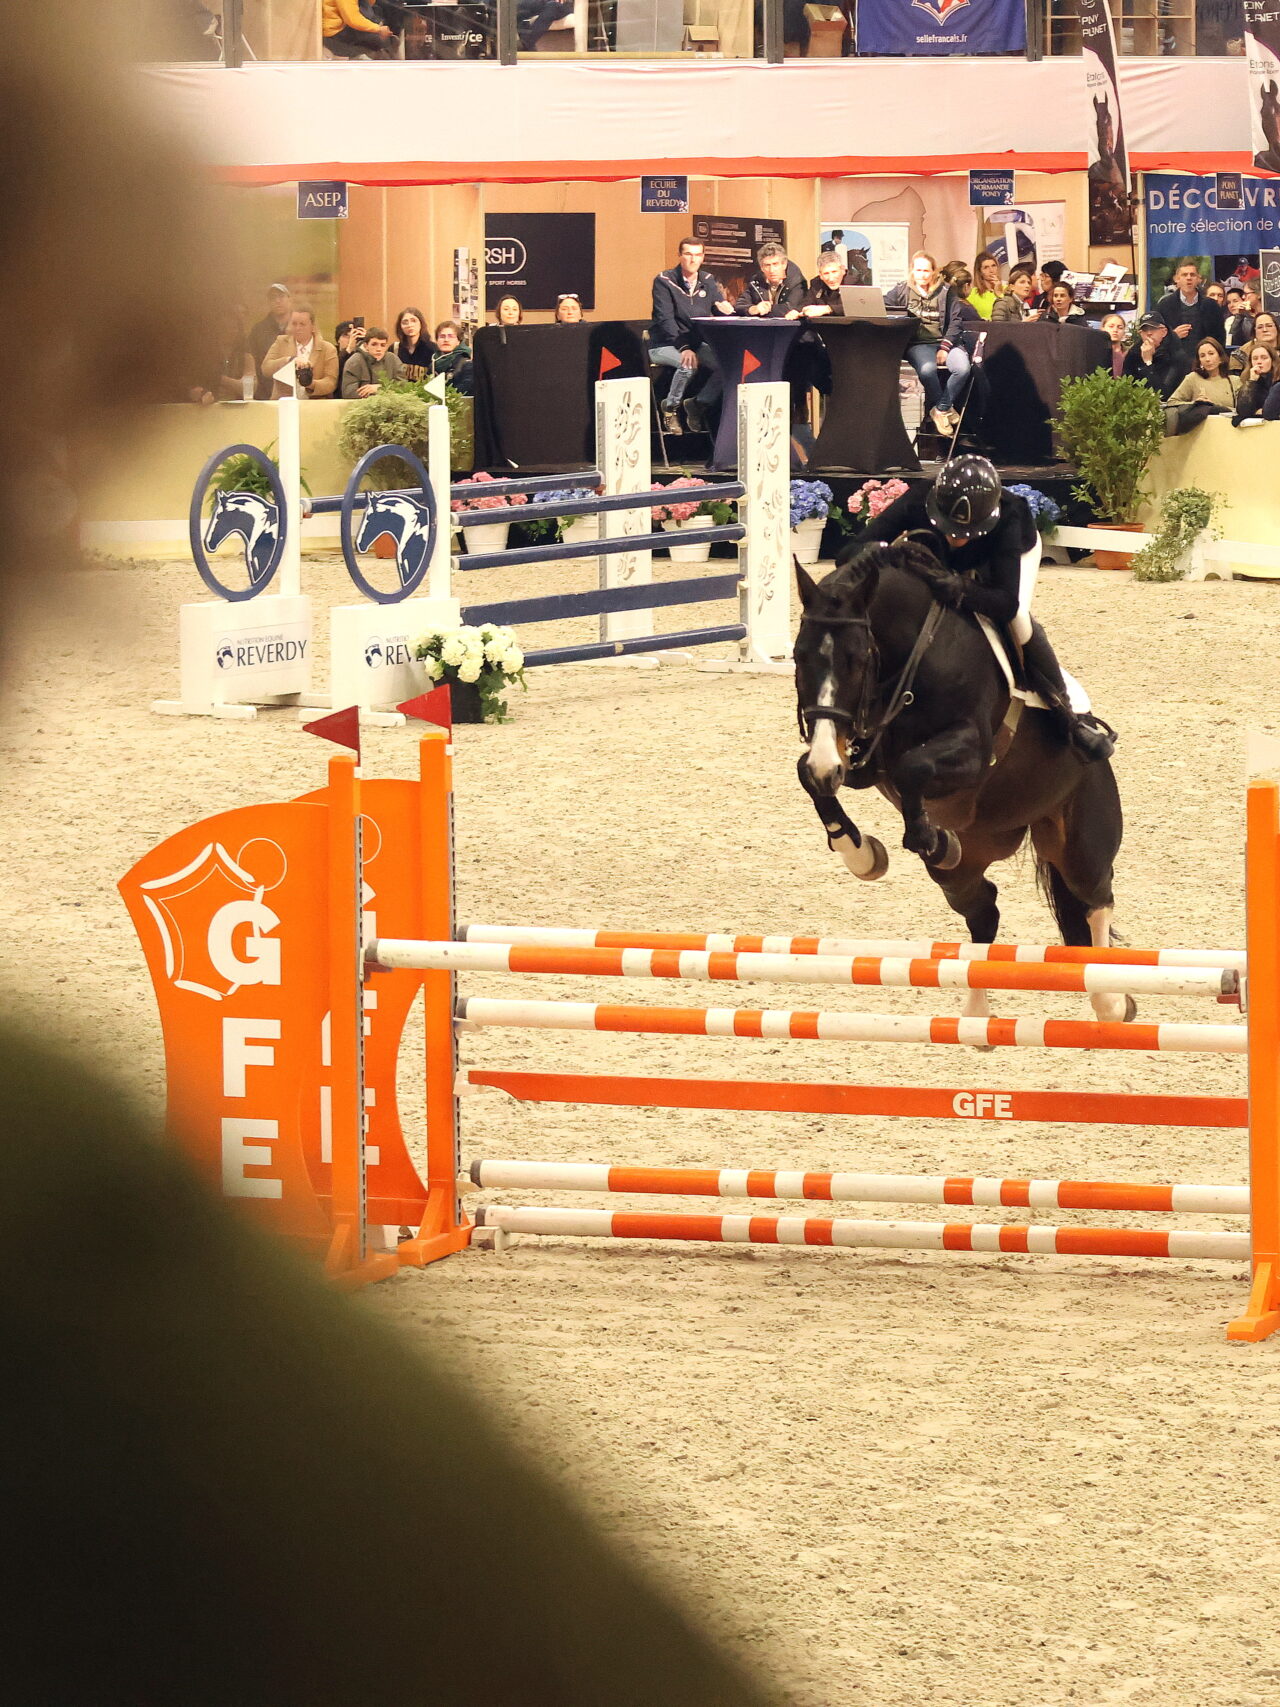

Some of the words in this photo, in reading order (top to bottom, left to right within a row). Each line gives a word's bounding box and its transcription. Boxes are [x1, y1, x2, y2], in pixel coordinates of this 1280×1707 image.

[650, 180, 678, 189] ECURIE
[304, 192, 341, 207] ASEP
[657, 189, 670, 198] DU
[646, 199, 681, 207] REVERDY
[1150, 219, 1187, 233] notre
[1190, 218, 1253, 232] sélection
[1256, 217, 1274, 231] de
[237, 640, 307, 667] REVERDY
[952, 1091, 1014, 1118] GFE
